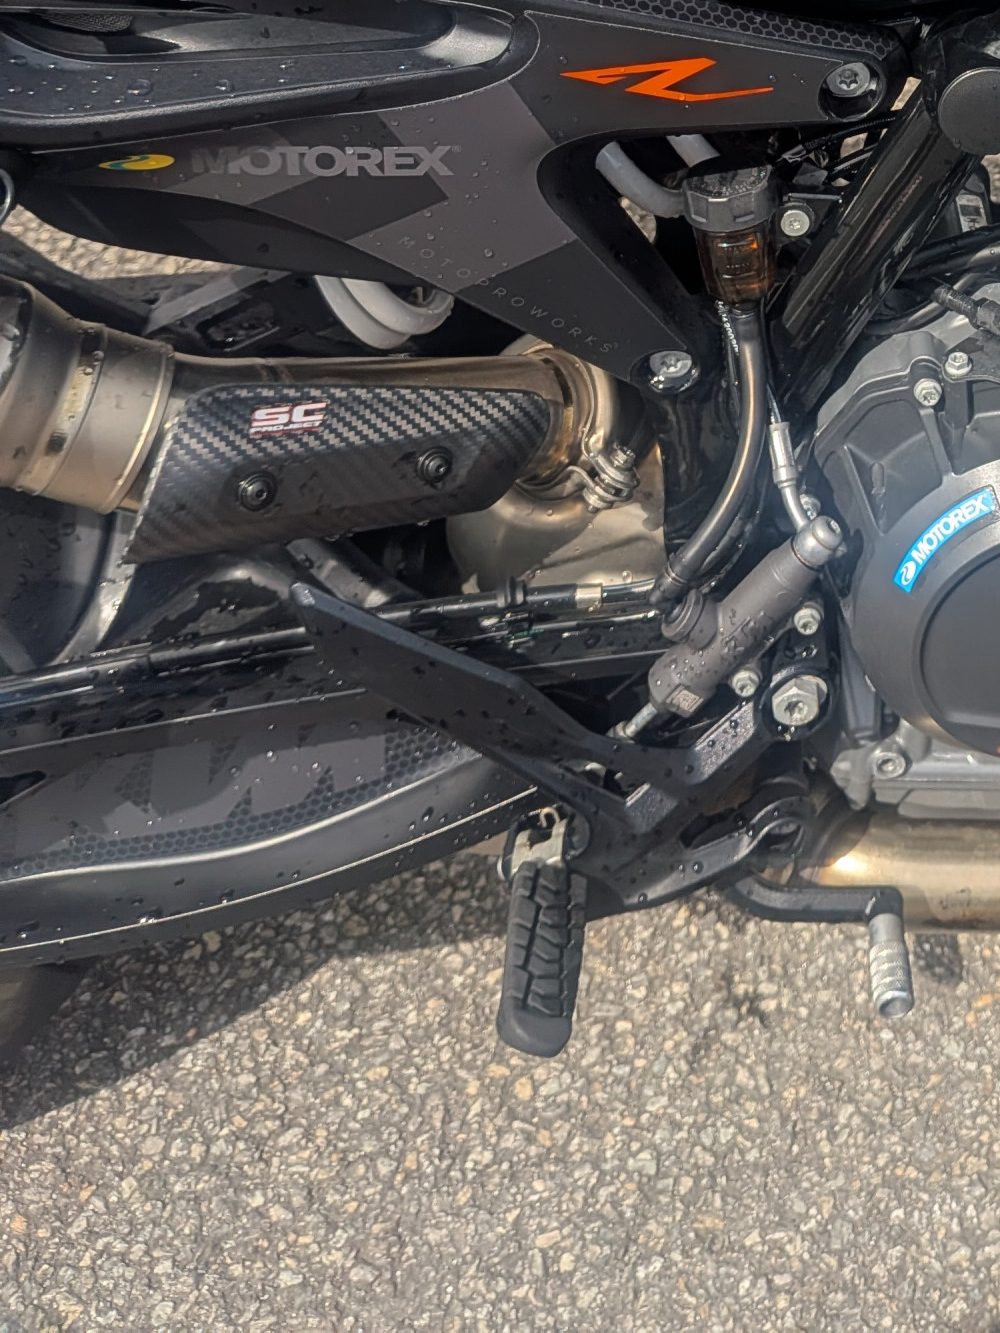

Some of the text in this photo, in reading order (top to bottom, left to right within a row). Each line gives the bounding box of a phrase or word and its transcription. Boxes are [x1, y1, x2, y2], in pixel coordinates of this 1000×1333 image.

[251, 402, 328, 425] SC
[249, 420, 323, 434] PROJECT
[911, 494, 988, 566] MOTOREX
